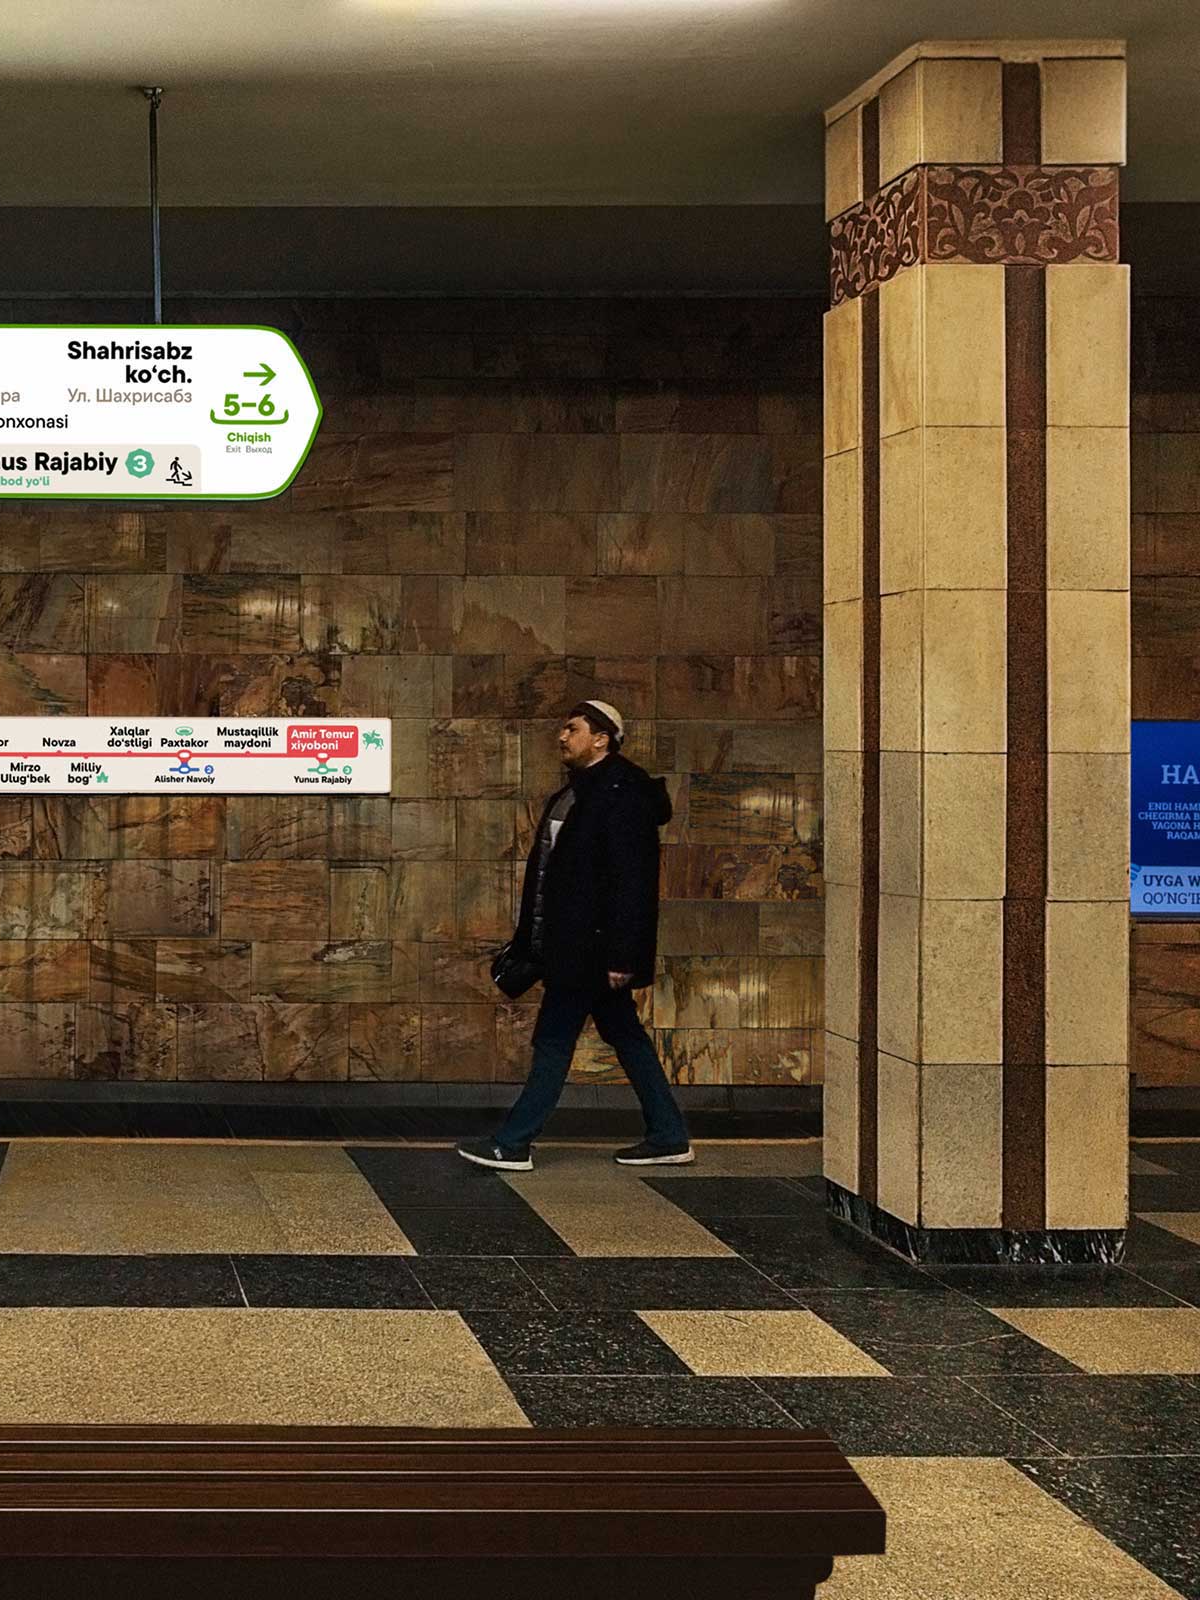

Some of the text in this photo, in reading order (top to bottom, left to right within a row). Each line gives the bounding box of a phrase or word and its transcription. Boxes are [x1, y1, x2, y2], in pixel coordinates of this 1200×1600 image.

[68, 341, 192, 360] Shahrisabz
[68, 388, 192, 405] Ул. Шахрисабз
[227, 432, 271, 444] Chiqish
[226, 445, 241, 453] Exit
[246, 445, 272, 454] Выход
[35, 452, 118, 475] Rajabiy
[132, 454, 148, 473] 3
[110, 727, 150, 738] Xalqlar
[217, 727, 278, 738] Mustaqillik
[291, 729, 354, 739] Amir Temur
[43, 738, 76, 747] Novza
[161, 738, 208, 747] Paxtakor
[224, 736, 271, 749] maydoni
[291, 740, 338, 752] xiyoboni
[10, 762, 40, 772] Mirzo
[71, 762, 101, 774] Milliy
[187, 776, 215, 784] Navoiy
[322, 776, 352, 784] Rajabiy
[1148, 802, 1171, 810] ENDI
[1138, 812, 1191, 820] CHEGIRMA
[1152, 821, 1191, 829] YAGONA
[1143, 875, 1184, 886] UYGA
